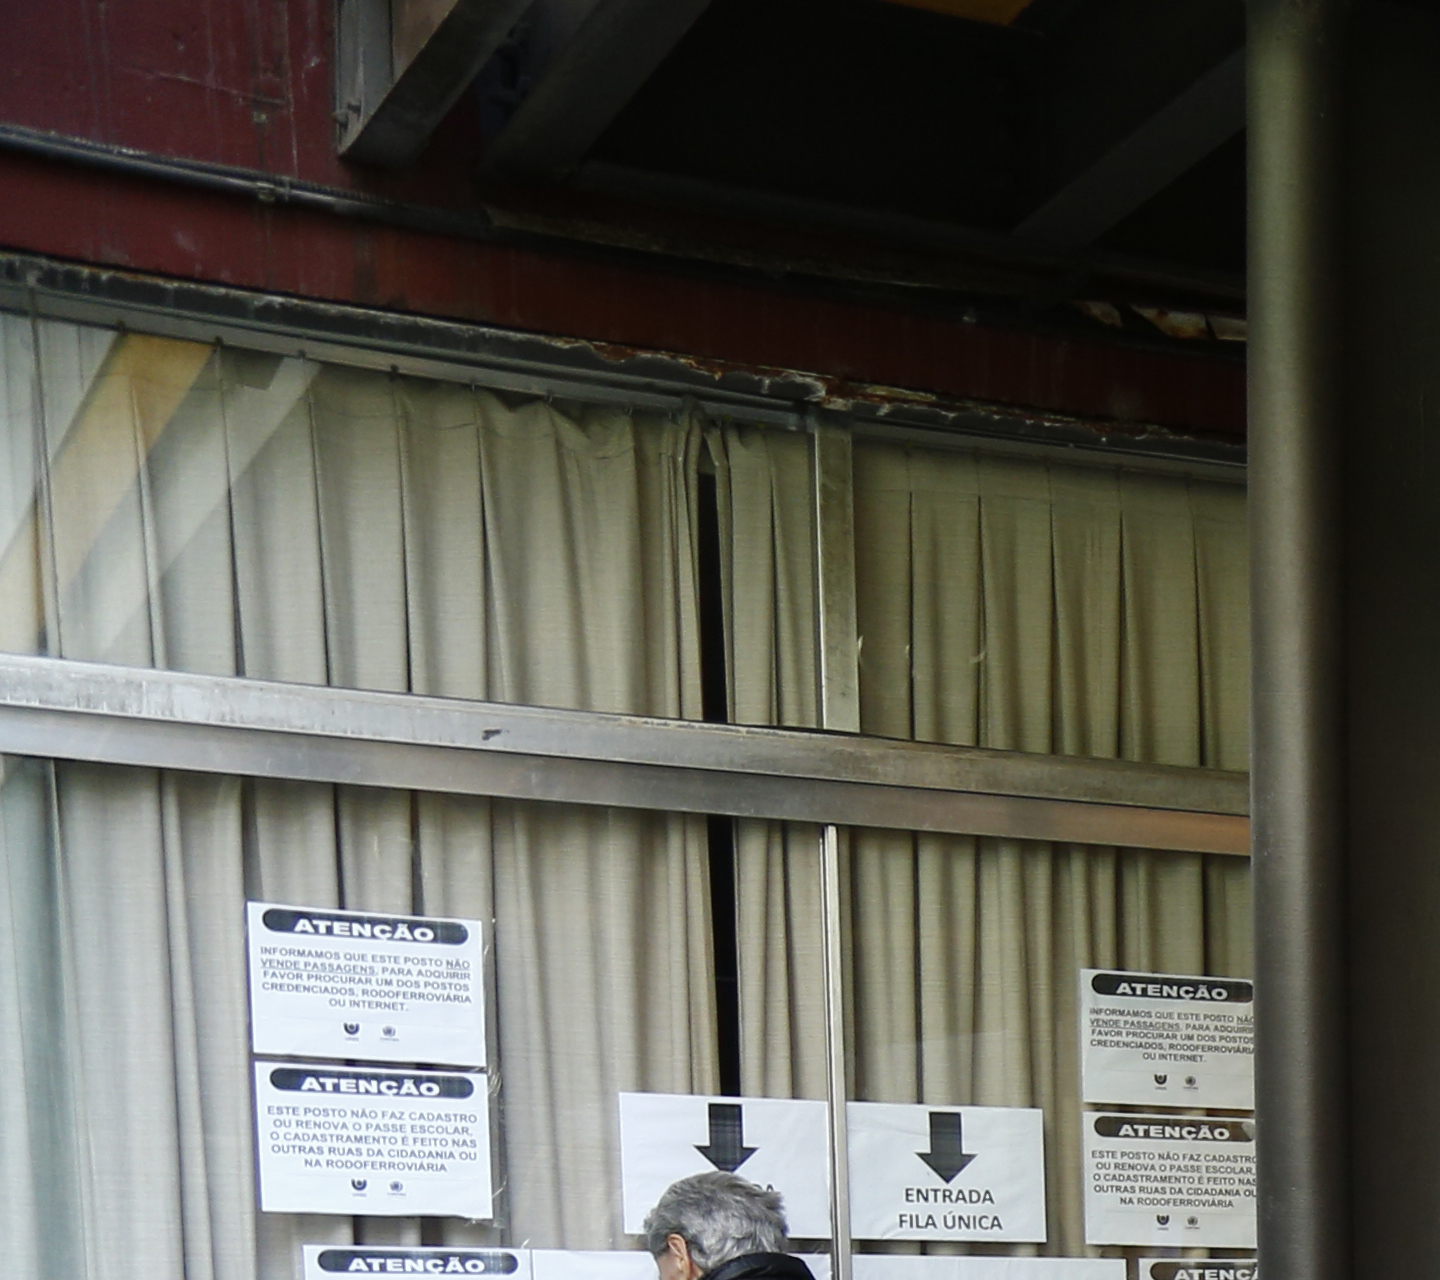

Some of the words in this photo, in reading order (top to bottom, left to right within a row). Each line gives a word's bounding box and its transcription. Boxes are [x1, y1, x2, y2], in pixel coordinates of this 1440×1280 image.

[294, 918, 435, 942] ATENÇÃO
[260, 947, 341, 960] INFORMAMOS
[344, 953, 368, 962] QUE
[371, 955, 400, 964] ESTE
[404, 957, 442, 967] POSTO
[446, 958, 470, 969] NÃO
[261, 959, 300, 969] VENDE
[382, 967, 412, 977] PARA
[417, 969, 470, 980] ADQUIRIR
[263, 971, 303, 981] FAVOR
[307, 974, 373, 984] PROCURAR
[376, 978, 393, 986] UM
[397, 980, 420, 989] DOS
[424, 981, 469, 992] POSTOS
[1116, 983, 1228, 1000] ATENÇÃO
[329, 998, 346, 1007] OU
[1090, 1008, 1152, 1018] INFORMAMOS
[1177, 1012, 1200, 1020] ESTE
[1204, 1014, 1234, 1023] POSTO
[1090, 1019, 1120, 1027] VENDE
[1126, 1031, 1177, 1040] PROCURAR
[1143, 1052, 1156, 1060] OU
[301, 1077, 440, 1096] ATENÇÃO
[267, 1106, 299, 1116] ESTE
[303, 1107, 347, 1118] POSTO
[351, 1108, 378, 1119] NÃO
[382, 1111, 405, 1120] FAZ
[409, 1112, 477, 1123] CADASTRO
[273, 1119, 291, 1128] OU
[296, 1120, 348, 1130] RENOVA
[353, 1123, 362, 1131] O
[366, 1123, 406, 1133] PASSE
[1119, 1124, 1230, 1140] ATENÇÃO
[270, 1132, 280, 1141] O
[284, 1132, 398, 1145] CADASTRAMENTO
[413, 1138, 448, 1147] FEITO
[452, 1139, 477, 1148] NAS
[271, 1144, 324, 1155] OUTRAS
[328, 1147, 363, 1157] RUAS
[367, 1148, 384, 1157] DA
[388, 1149, 456, 1160] CIDADANIA
[459, 1152, 477, 1161] OU
[1092, 1150, 1118, 1159] ESTE
[1120, 1151, 1155, 1160] POSTO
[1158, 1152, 1179, 1161] NÃO
[1182, 1154, 1201, 1162] FAZ
[304, 1159, 322, 1168] NA
[1096, 1162, 1111, 1170] OU
[1114, 1163, 1156, 1171] RENOVA
[1170, 1165, 1201, 1173] PASSE
[1093, 1173, 1101, 1181] O
[1104, 1174, 1195, 1184] CADASTRAMENTO
[1207, 1177, 1235, 1185] FEITO
[905, 1188, 995, 1204] ENTRADA
[1094, 1185, 1136, 1193] OUTRAS
[1139, 1186, 1166, 1195] RUAS
[1170, 1187, 1184, 1195] DA
[1187, 1187, 1241, 1197] CIDADANIA
[1120, 1197, 1134, 1205] NA
[899, 1214, 936, 1229] FILA
[943, 1211, 1003, 1230] ÚNICA
[349, 1257, 485, 1274] ATENÇÃO
